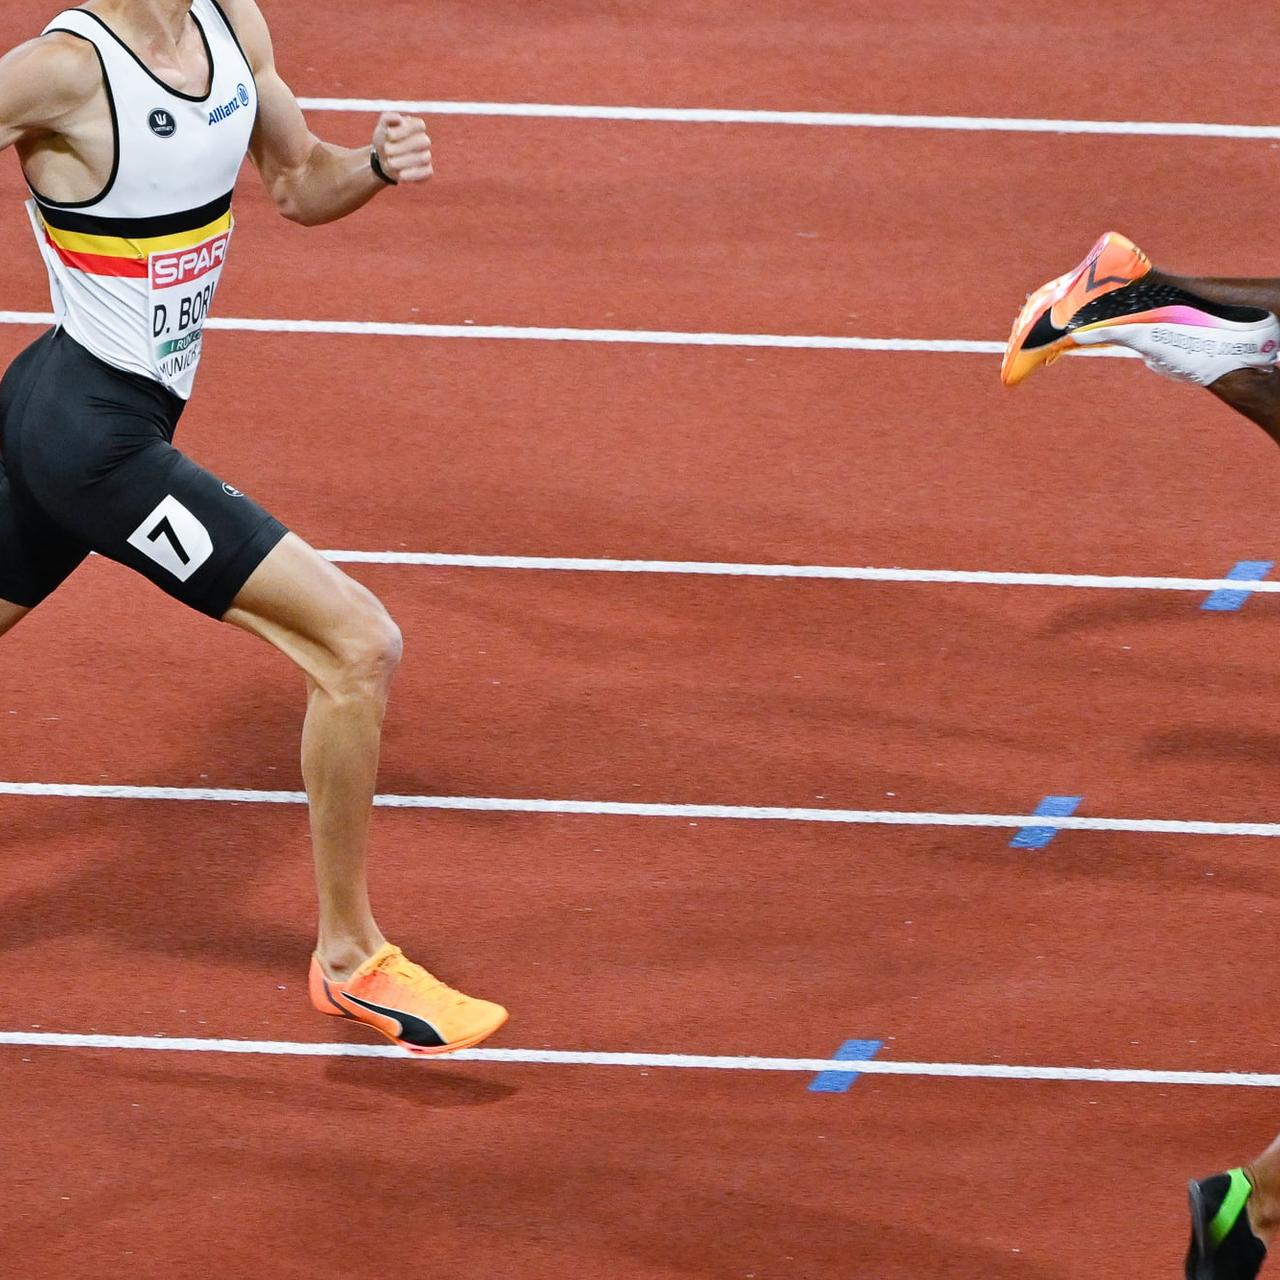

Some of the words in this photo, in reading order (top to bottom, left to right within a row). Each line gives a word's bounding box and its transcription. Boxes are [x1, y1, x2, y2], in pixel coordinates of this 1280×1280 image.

[208, 97, 240, 126] Allianz
[153, 304, 170, 338] D.
[146, 515, 191, 566] 7
